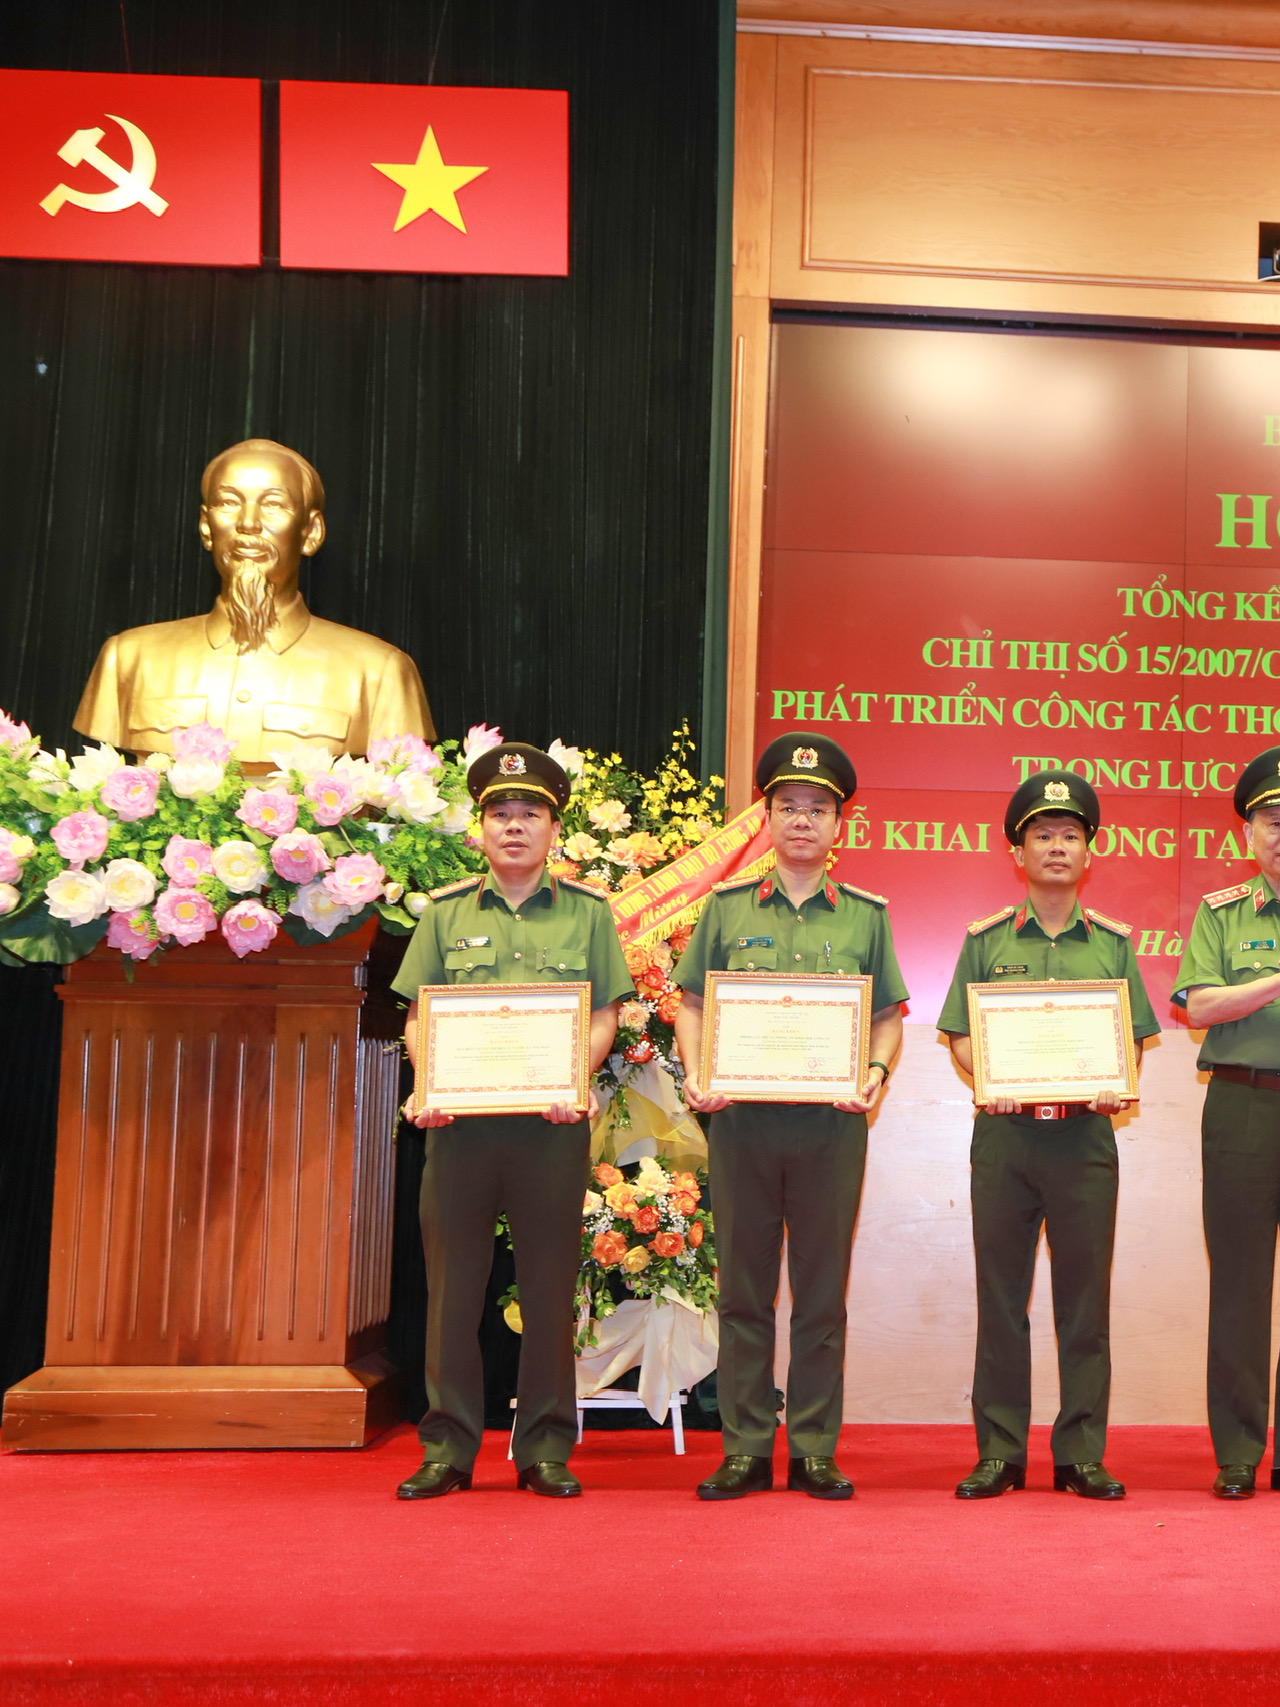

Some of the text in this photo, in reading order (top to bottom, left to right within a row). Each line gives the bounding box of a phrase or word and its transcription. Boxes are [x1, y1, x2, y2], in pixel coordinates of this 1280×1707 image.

[1117, 574, 1226, 619] TỔNG
[923, 629, 994, 668] CHỈ
[1001, 640, 1070, 677] THỊ
[1078, 631, 1128, 672] SỐ
[772, 685, 878, 721] PHÁT
[885, 682, 1006, 725] TRIỂN
[1013, 691, 1126, 729] CÔNG
[1134, 695, 1212, 732] TÁC
[1159, 759, 1235, 796] LỰC
[884, 821, 990, 852] KHAI
[1189, 829, 1257, 866] TẠ
[1135, 930, 1183, 956] Hà
